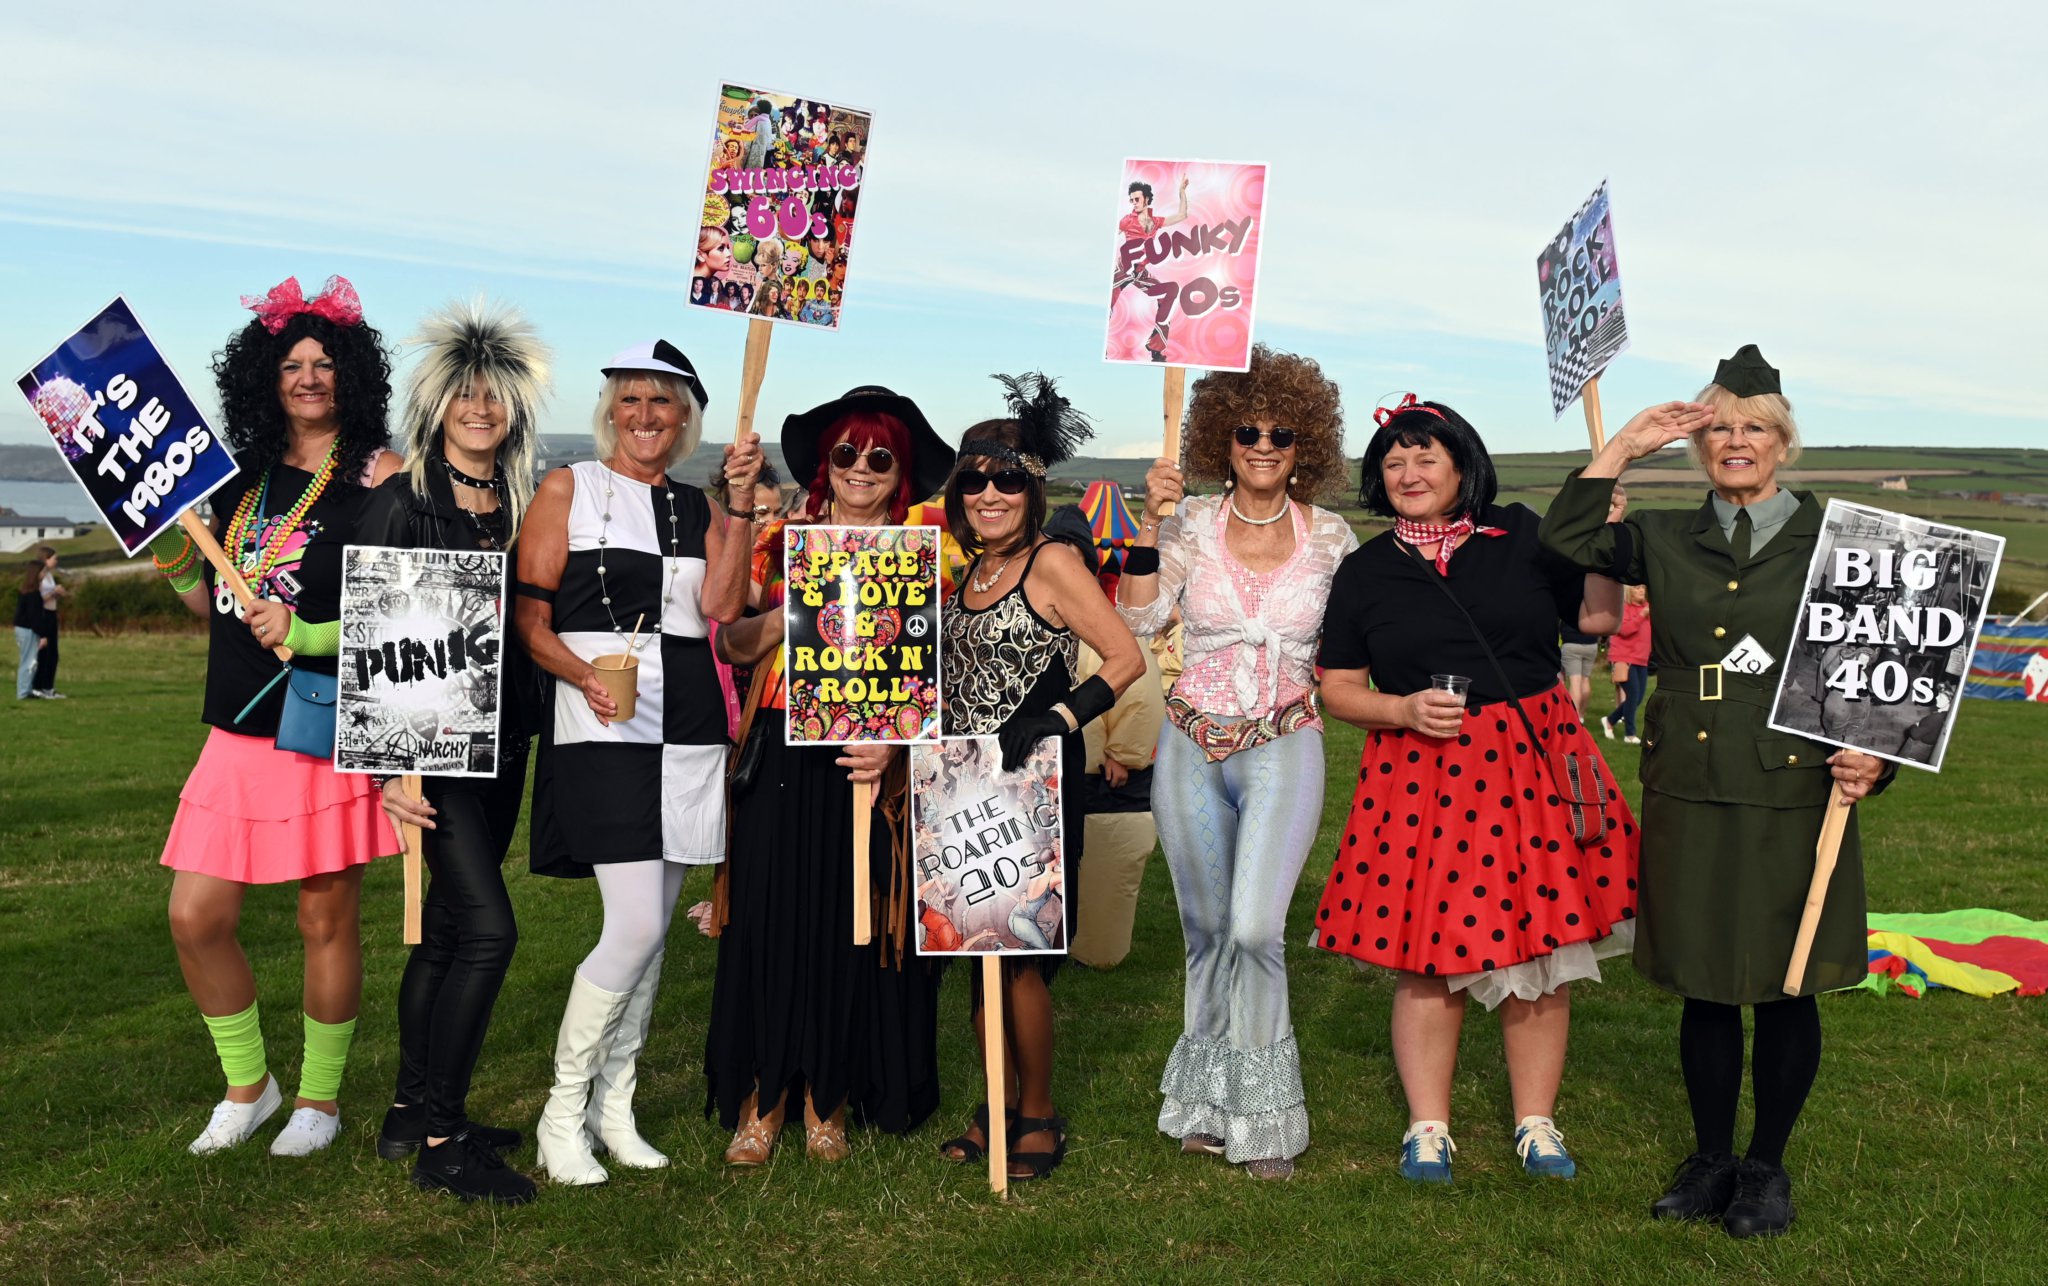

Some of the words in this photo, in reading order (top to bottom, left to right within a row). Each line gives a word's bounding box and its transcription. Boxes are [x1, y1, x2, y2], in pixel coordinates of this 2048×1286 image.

[710, 164, 858, 194] SWINGING
[746, 195, 829, 241] 60s
[1120, 216, 1253, 275] FUNKY
[1148, 277, 1242, 325] 70s
[1555, 258, 1610, 342] ROLL
[1569, 300, 1608, 356] 50s
[72, 373, 138, 454] IT'S
[98, 397, 171, 482] THE
[122, 426, 210, 528] 1980s
[809, 551, 919, 576] PEACE
[1833, 548, 1939, 590] BIG
[803, 582, 823, 607] &
[839, 582, 926, 606] LOVE
[856, 611, 876, 637] &
[1806, 602, 1965, 648] BAND
[356, 625, 497, 690] PUNK
[820, 677, 911, 702] ROLL
[1825, 659, 1935, 704] 40s
[945, 795, 1006, 834] THE
[918, 803, 1059, 882] ROARING
[960, 852, 1046, 907] 20s
